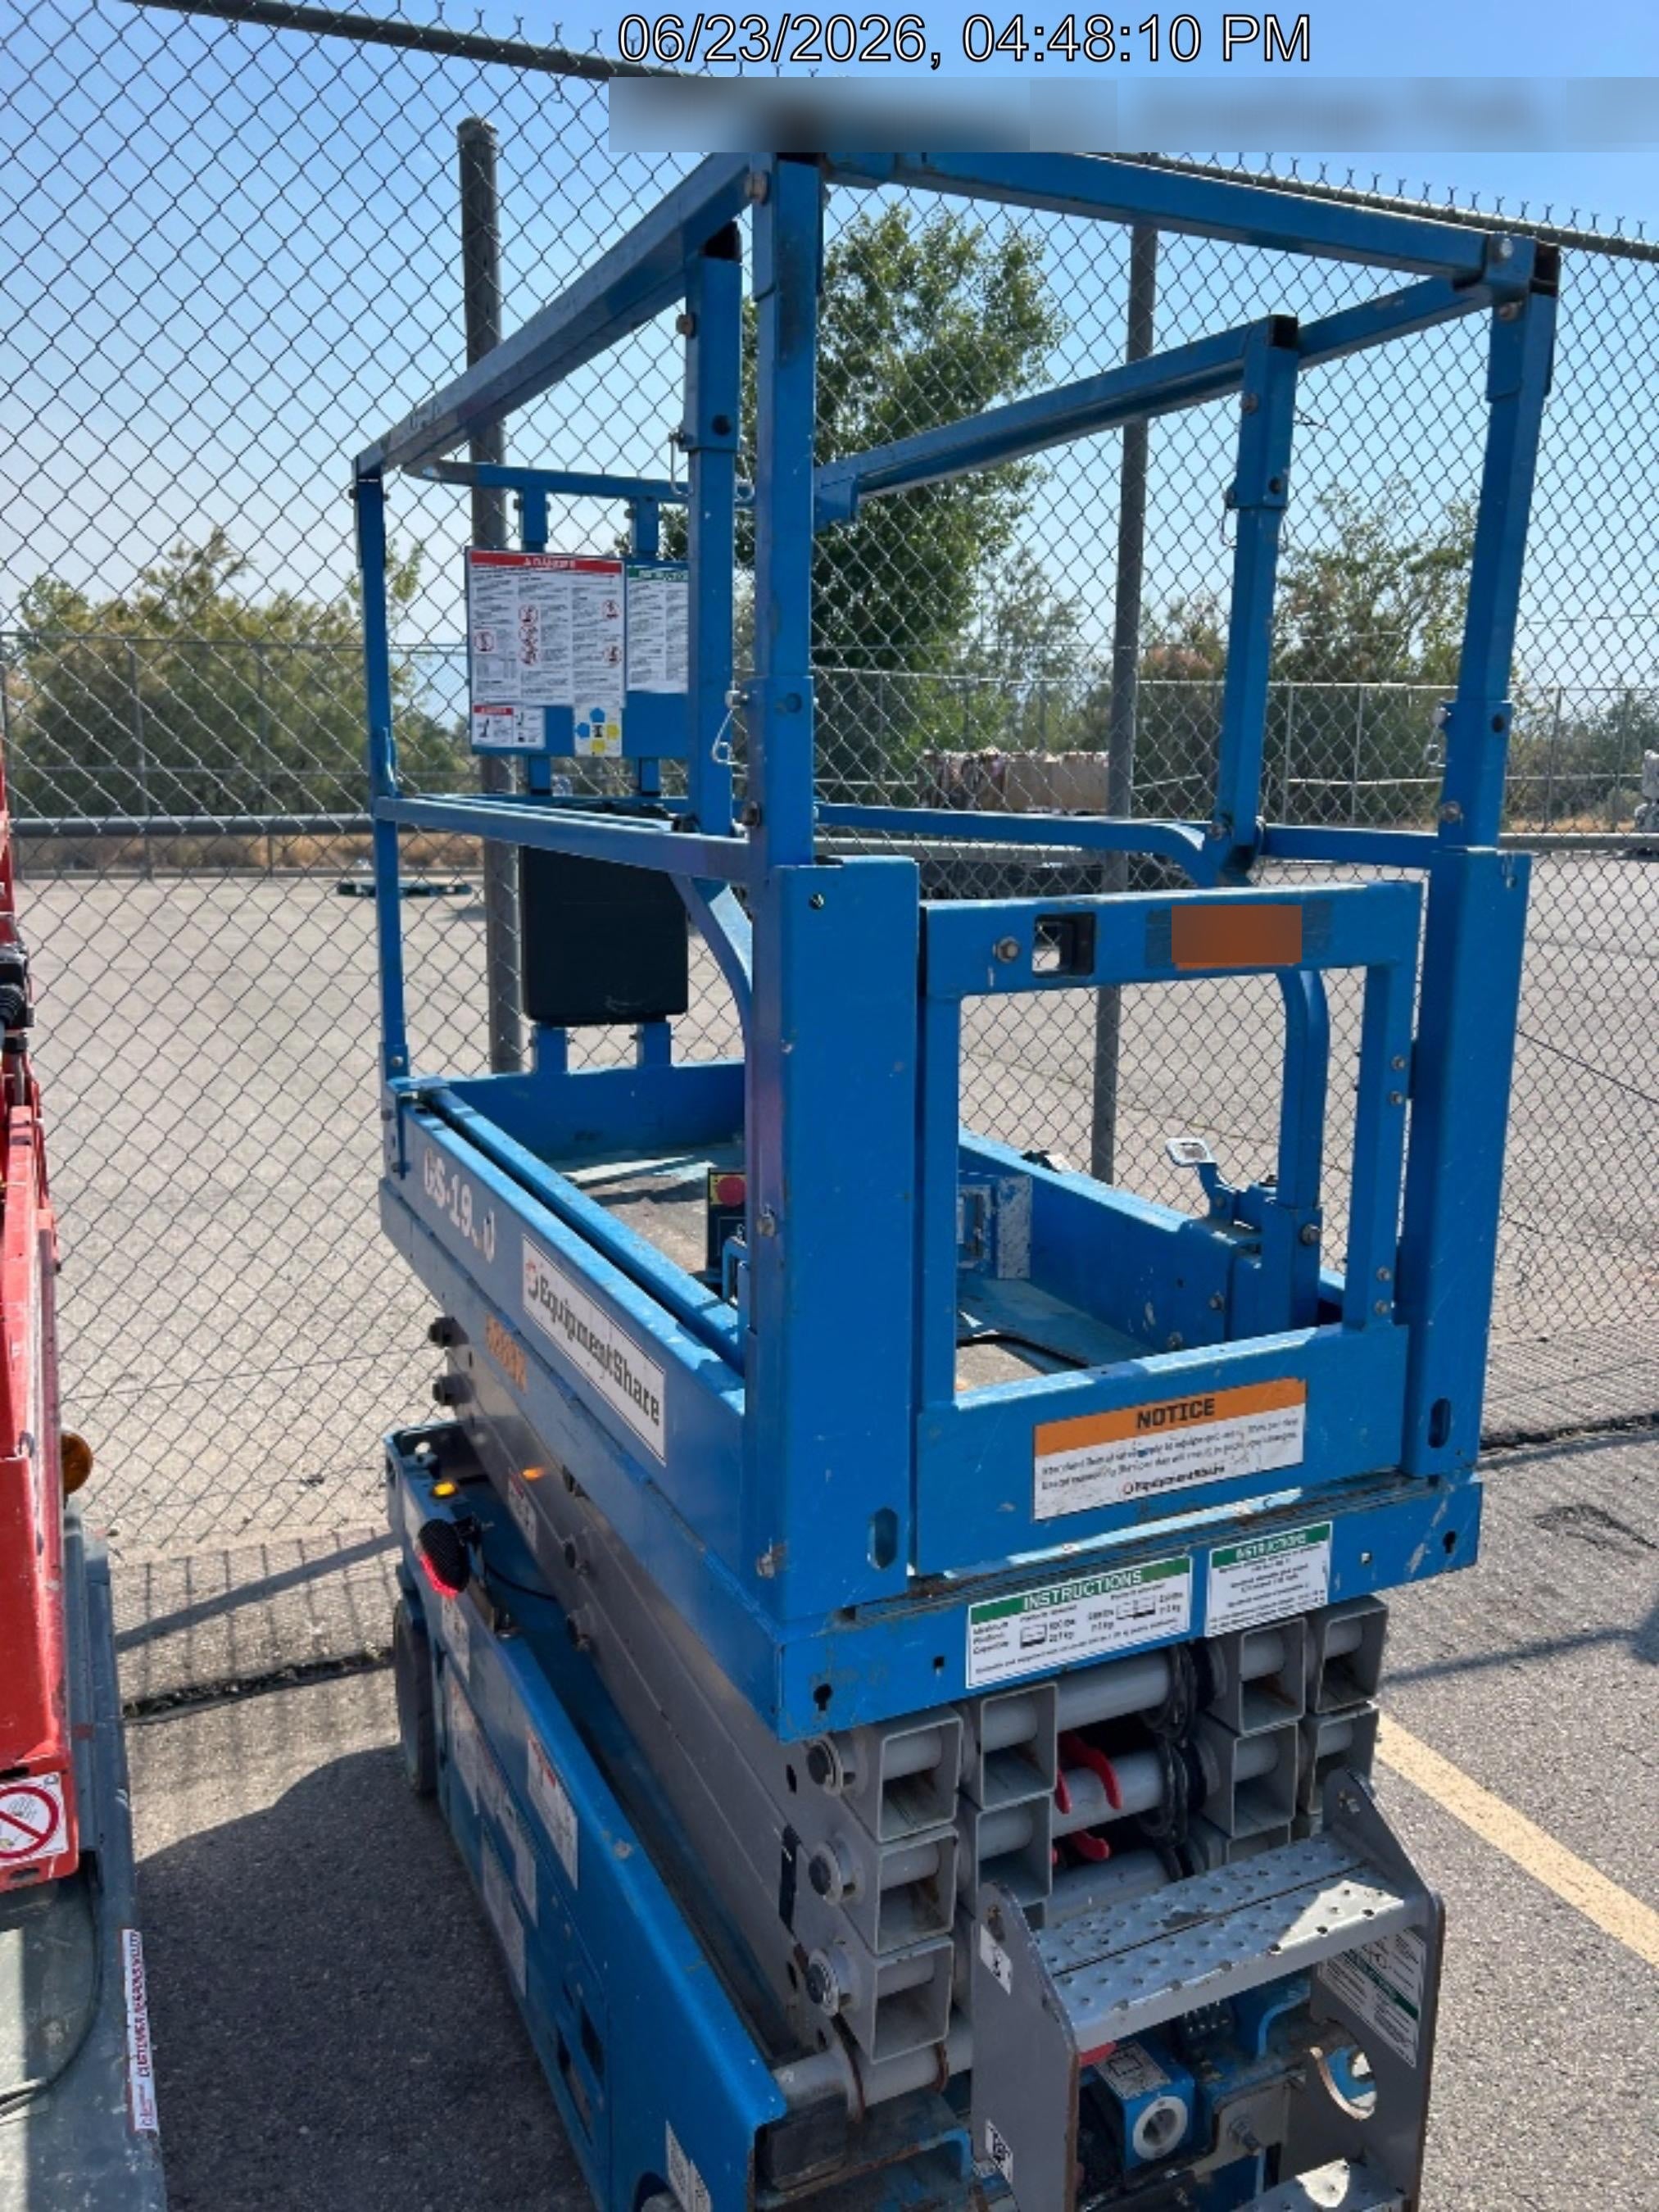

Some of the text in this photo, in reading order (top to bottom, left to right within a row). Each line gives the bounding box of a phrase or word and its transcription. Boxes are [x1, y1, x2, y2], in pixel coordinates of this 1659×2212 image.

[539, 1276, 660, 1425] EquipmentShare
[1135, 1398, 1216, 1430] NOTICE
[1023, 1569, 1142, 1611] INSTRUCTIONS
